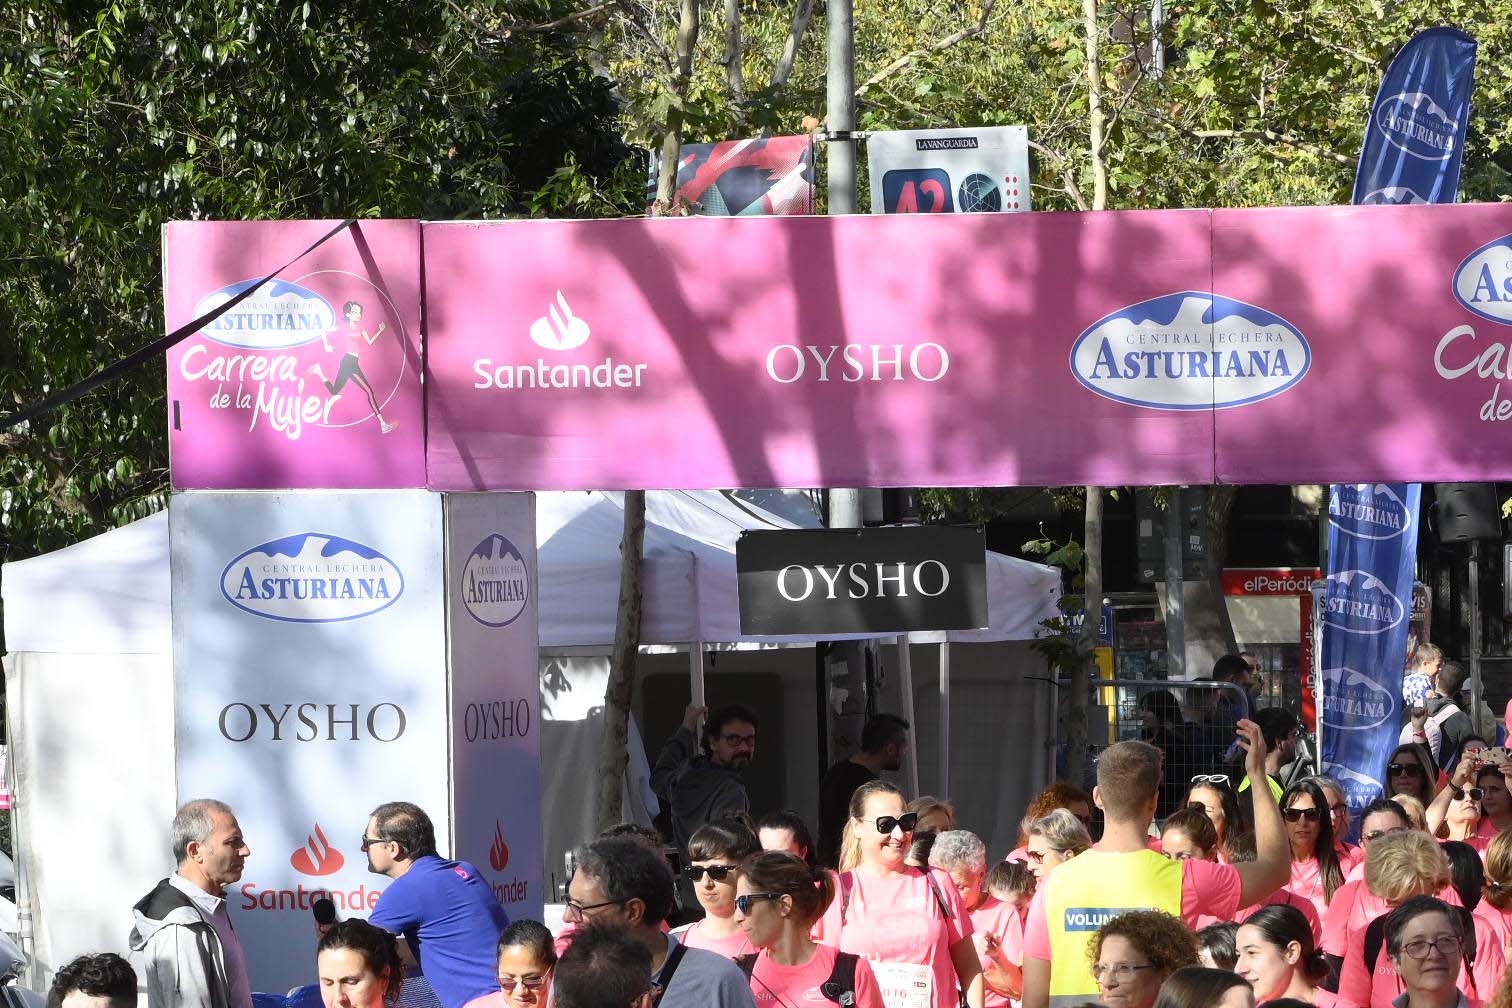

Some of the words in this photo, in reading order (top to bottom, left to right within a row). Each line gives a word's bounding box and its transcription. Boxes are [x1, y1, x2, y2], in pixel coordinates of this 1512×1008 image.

[1382, 106, 1453, 150] ASTURIANA
[1126, 332, 1201, 345] CENTRAL
[1209, 331, 1284, 344] LECHERA
[180, 344, 298, 381] Carrera
[473, 357, 648, 390] Santander
[766, 342, 950, 384] OYSHO
[1090, 336, 1292, 380] ASTURIANA
[210, 383, 231, 409] de
[237, 380, 251, 409] la
[249, 377, 342, 440] Mujer
[1329, 492, 1401, 529] ASTURIANA
[235, 566, 390, 600] ASTURIANA
[263, 564, 321, 573] CENTRAL
[326, 564, 384, 573] LECHERA
[467, 569, 525, 604] ASTURIANA
[776, 558, 951, 602] OYSHO
[218, 702, 407, 742] OYSHO
[463, 698, 531, 744] OYSHO
